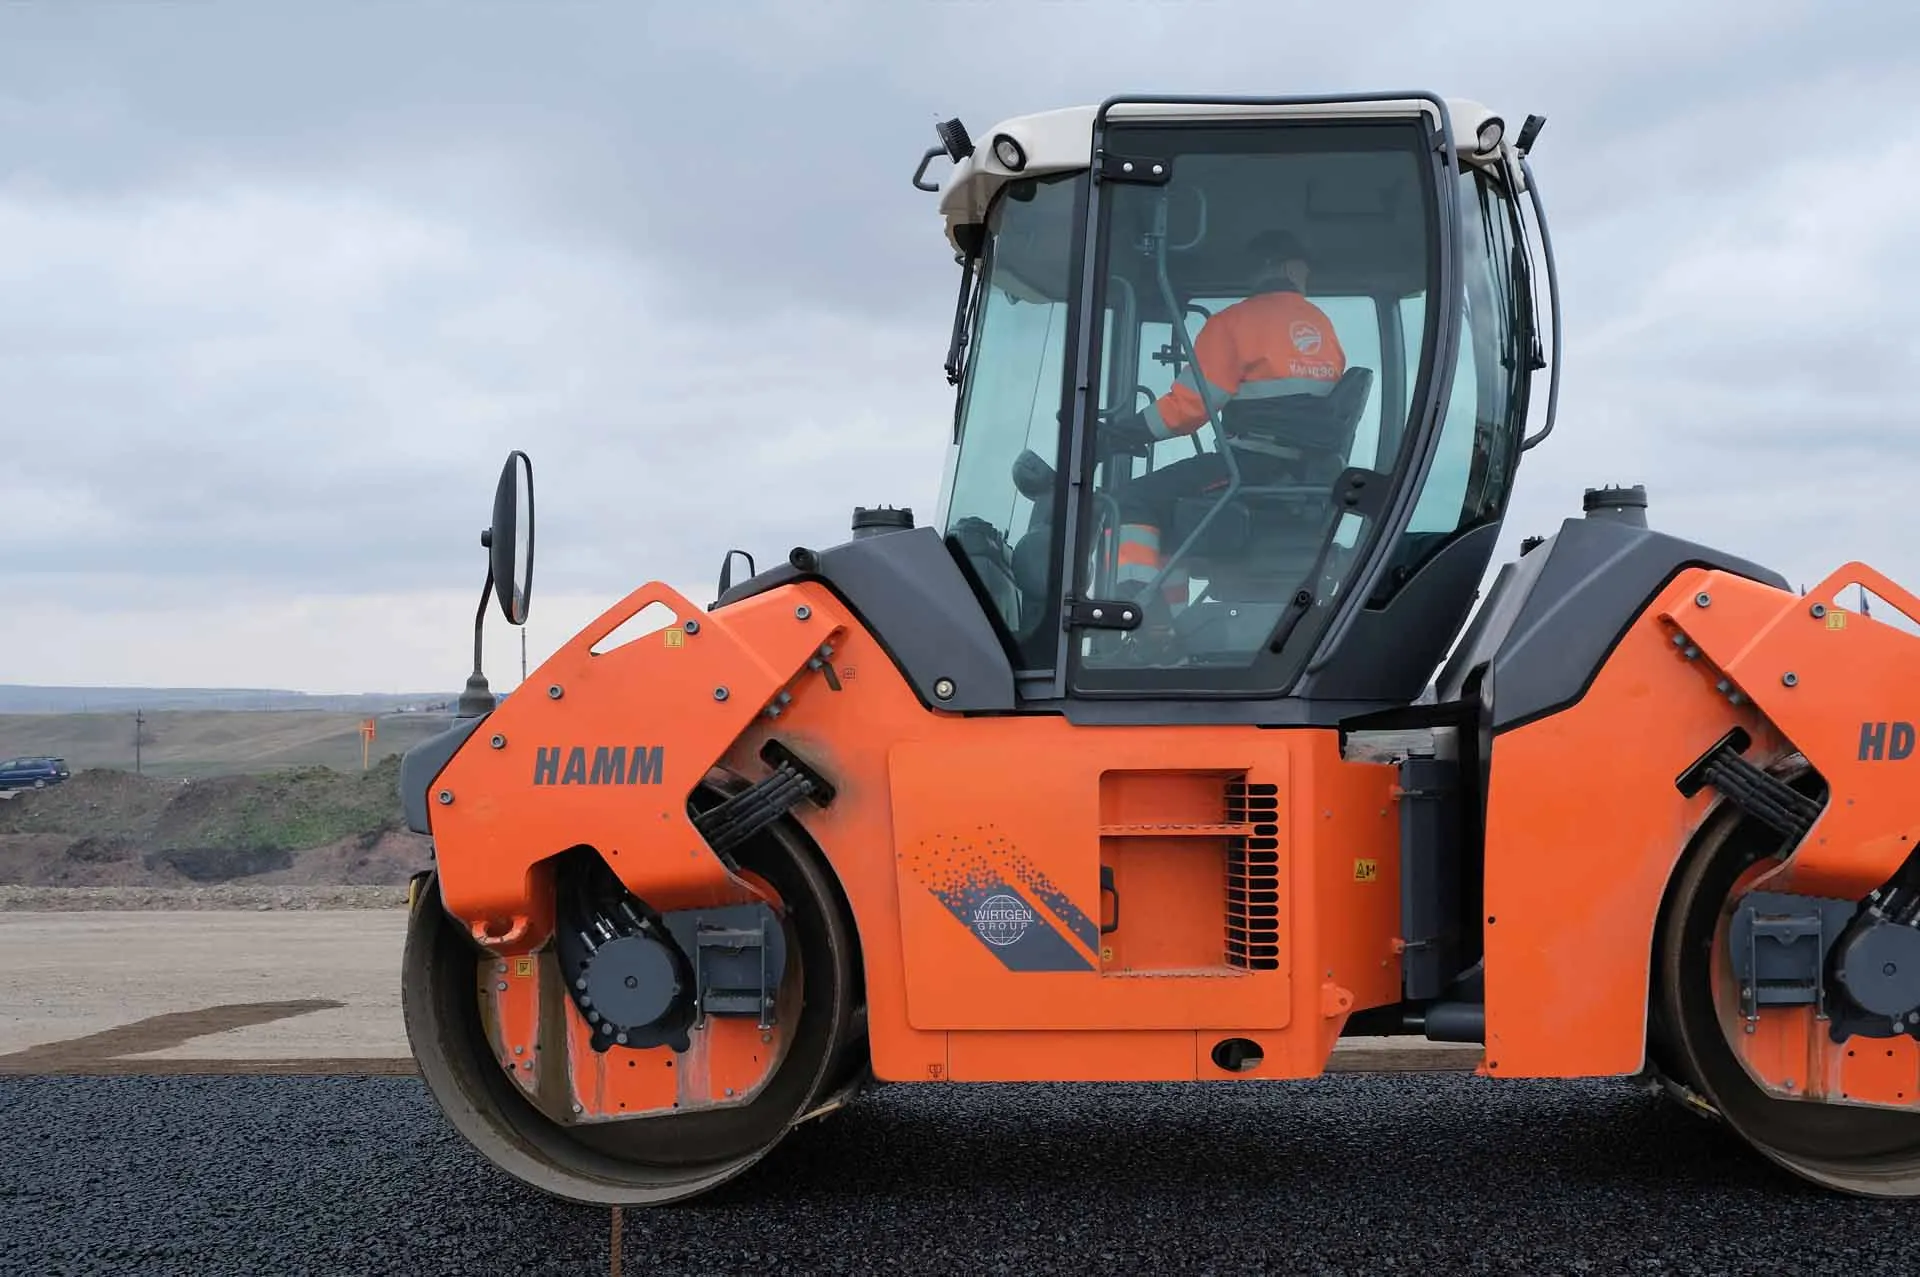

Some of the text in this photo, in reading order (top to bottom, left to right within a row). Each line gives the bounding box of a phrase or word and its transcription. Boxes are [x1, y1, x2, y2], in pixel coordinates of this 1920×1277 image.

[1858, 722, 1915, 761] HD
[533, 746, 664, 785] HAMM
[974, 909, 1032, 920] WIRTGEN
[977, 922, 1028, 931] GROUP
